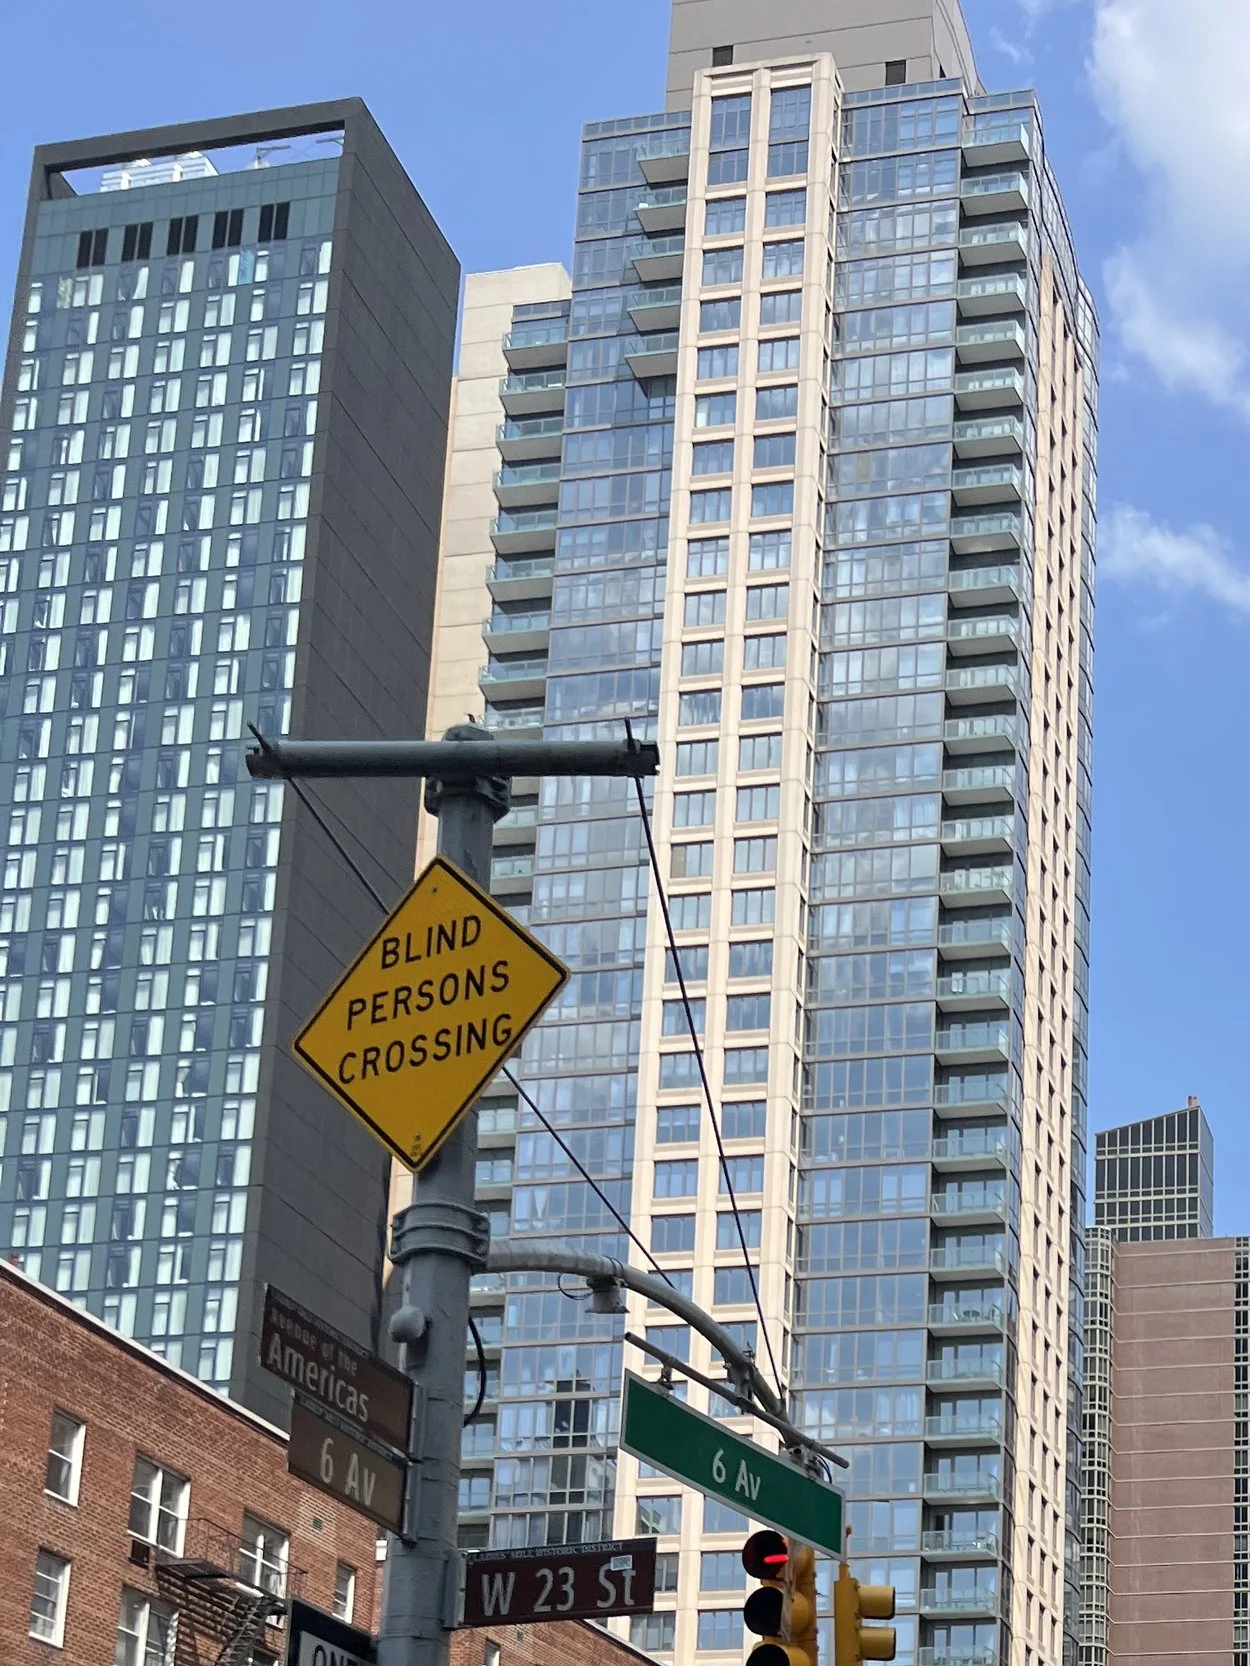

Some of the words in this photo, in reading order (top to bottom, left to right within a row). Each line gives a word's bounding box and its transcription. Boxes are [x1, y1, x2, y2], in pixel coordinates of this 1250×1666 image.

[381, 914, 481, 969] BLIND
[346, 960, 509, 1030] PERSONS
[338, 1013, 512, 1085] CROSSING
[267, 1332, 369, 1423] Americas
[319, 1437, 335, 1484] 6
[344, 1452, 377, 1506] Av
[712, 1448, 727, 1484] 6
[735, 1459, 761, 1501] Av
[581, 1543, 624, 1555] DISTRICT
[481, 1571, 516, 1617] W
[533, 1566, 576, 1613] 23
[596, 1562, 637, 1609] St
